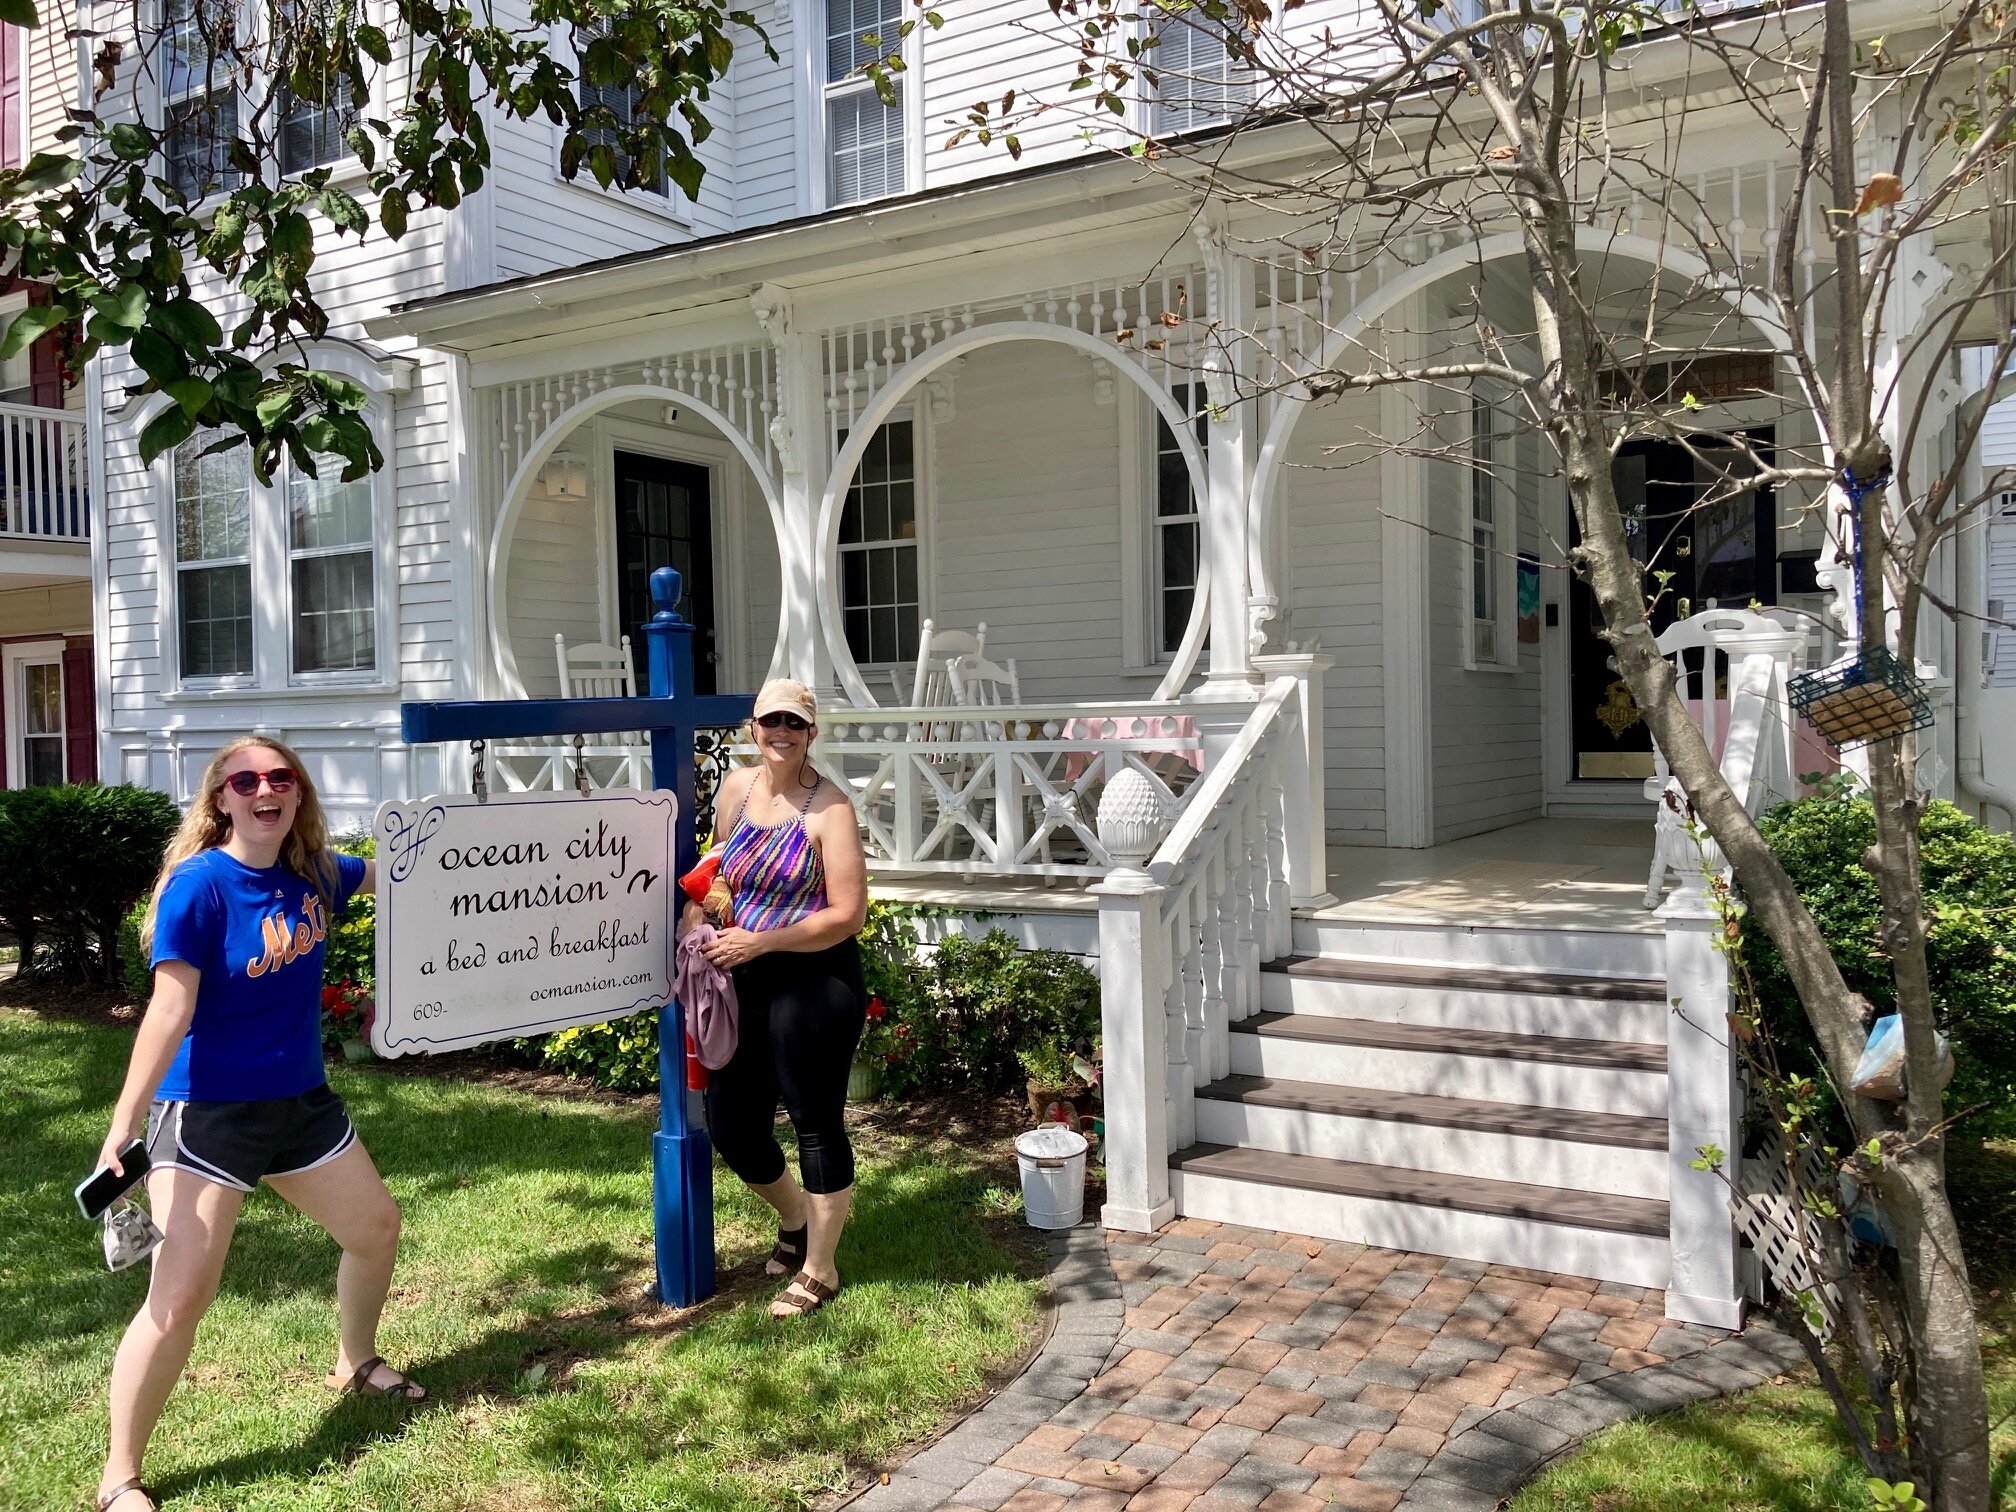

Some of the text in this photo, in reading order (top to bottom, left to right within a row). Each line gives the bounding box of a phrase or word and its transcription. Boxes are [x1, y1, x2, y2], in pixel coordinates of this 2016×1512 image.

[439, 818, 632, 879] ocean city
[450, 873, 609, 917] mansion
[420, 918, 650, 975] a bed and breakfast
[530, 969, 654, 1001] ocmansion.com
